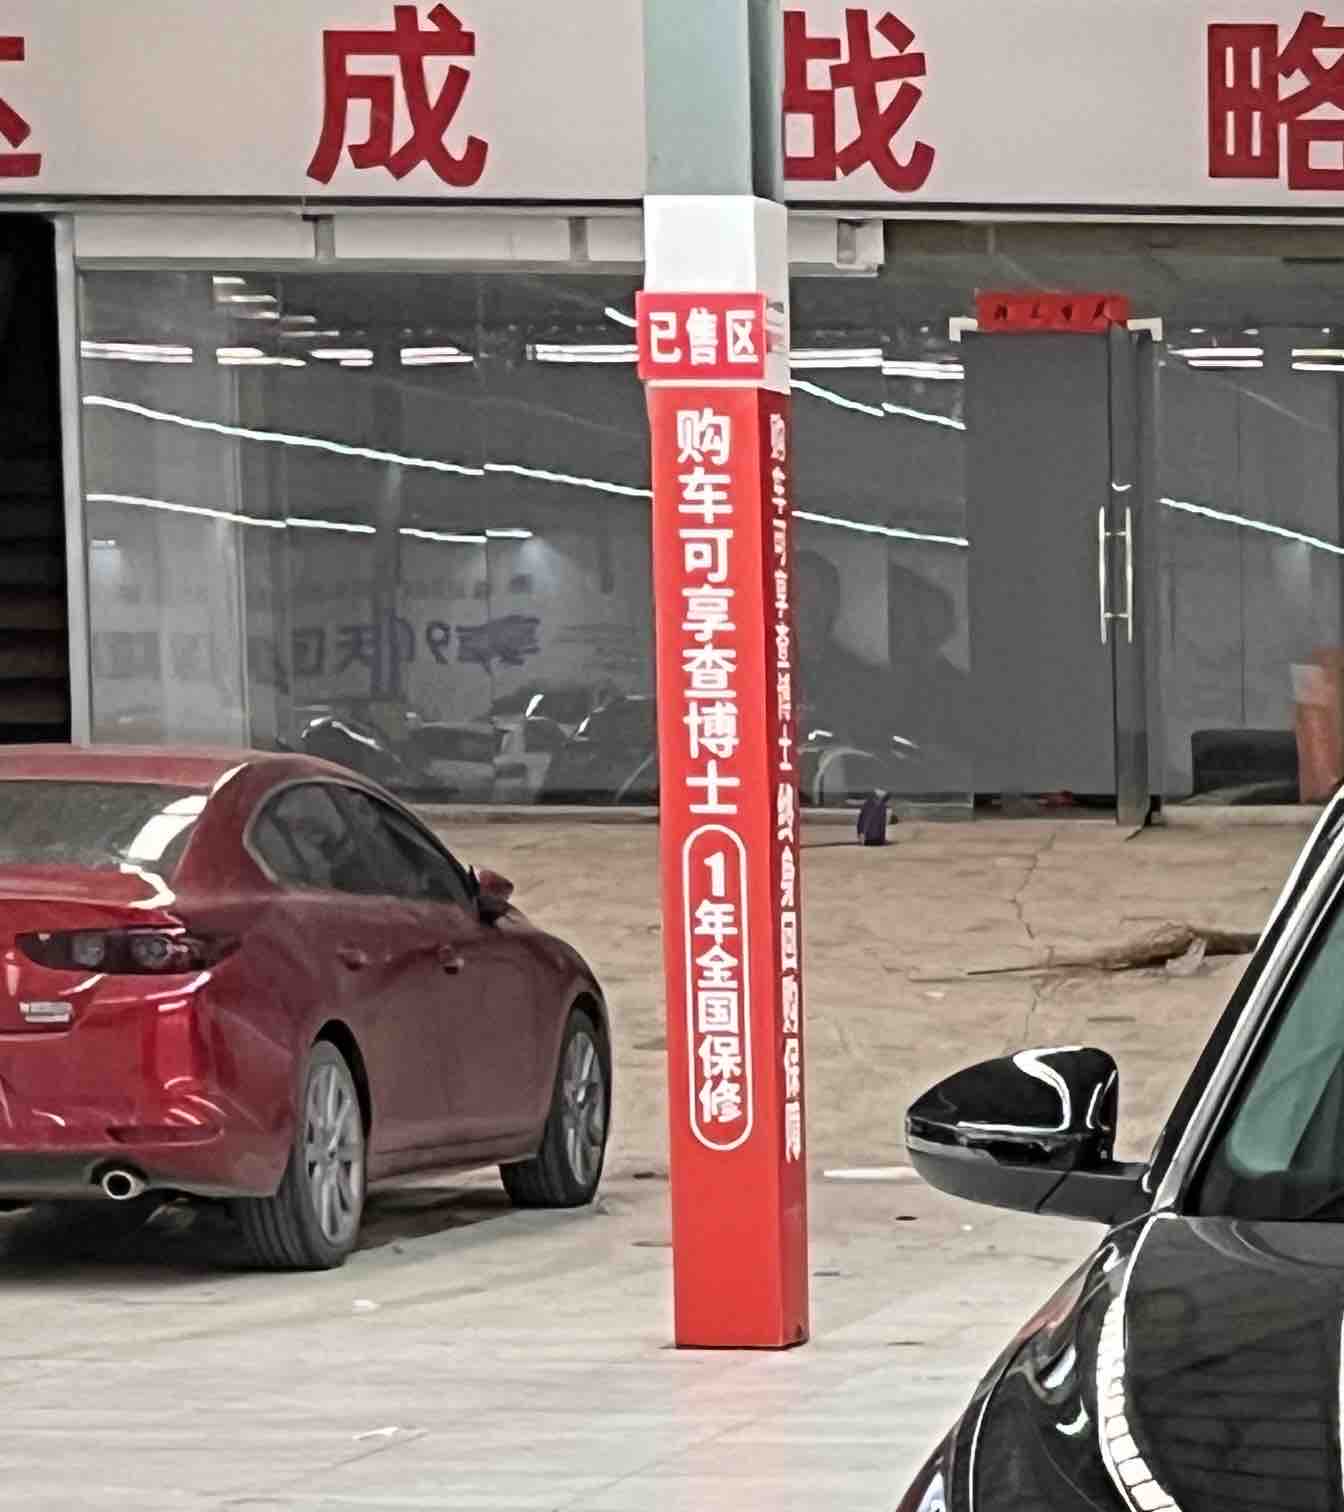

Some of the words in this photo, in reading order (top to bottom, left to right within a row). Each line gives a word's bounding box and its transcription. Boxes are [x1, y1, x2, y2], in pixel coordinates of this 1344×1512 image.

[648, 307, 759, 366] 已售区
[676, 407, 741, 815] 购车可享查博士
[694, 850, 743, 1123] 1年全国保修
